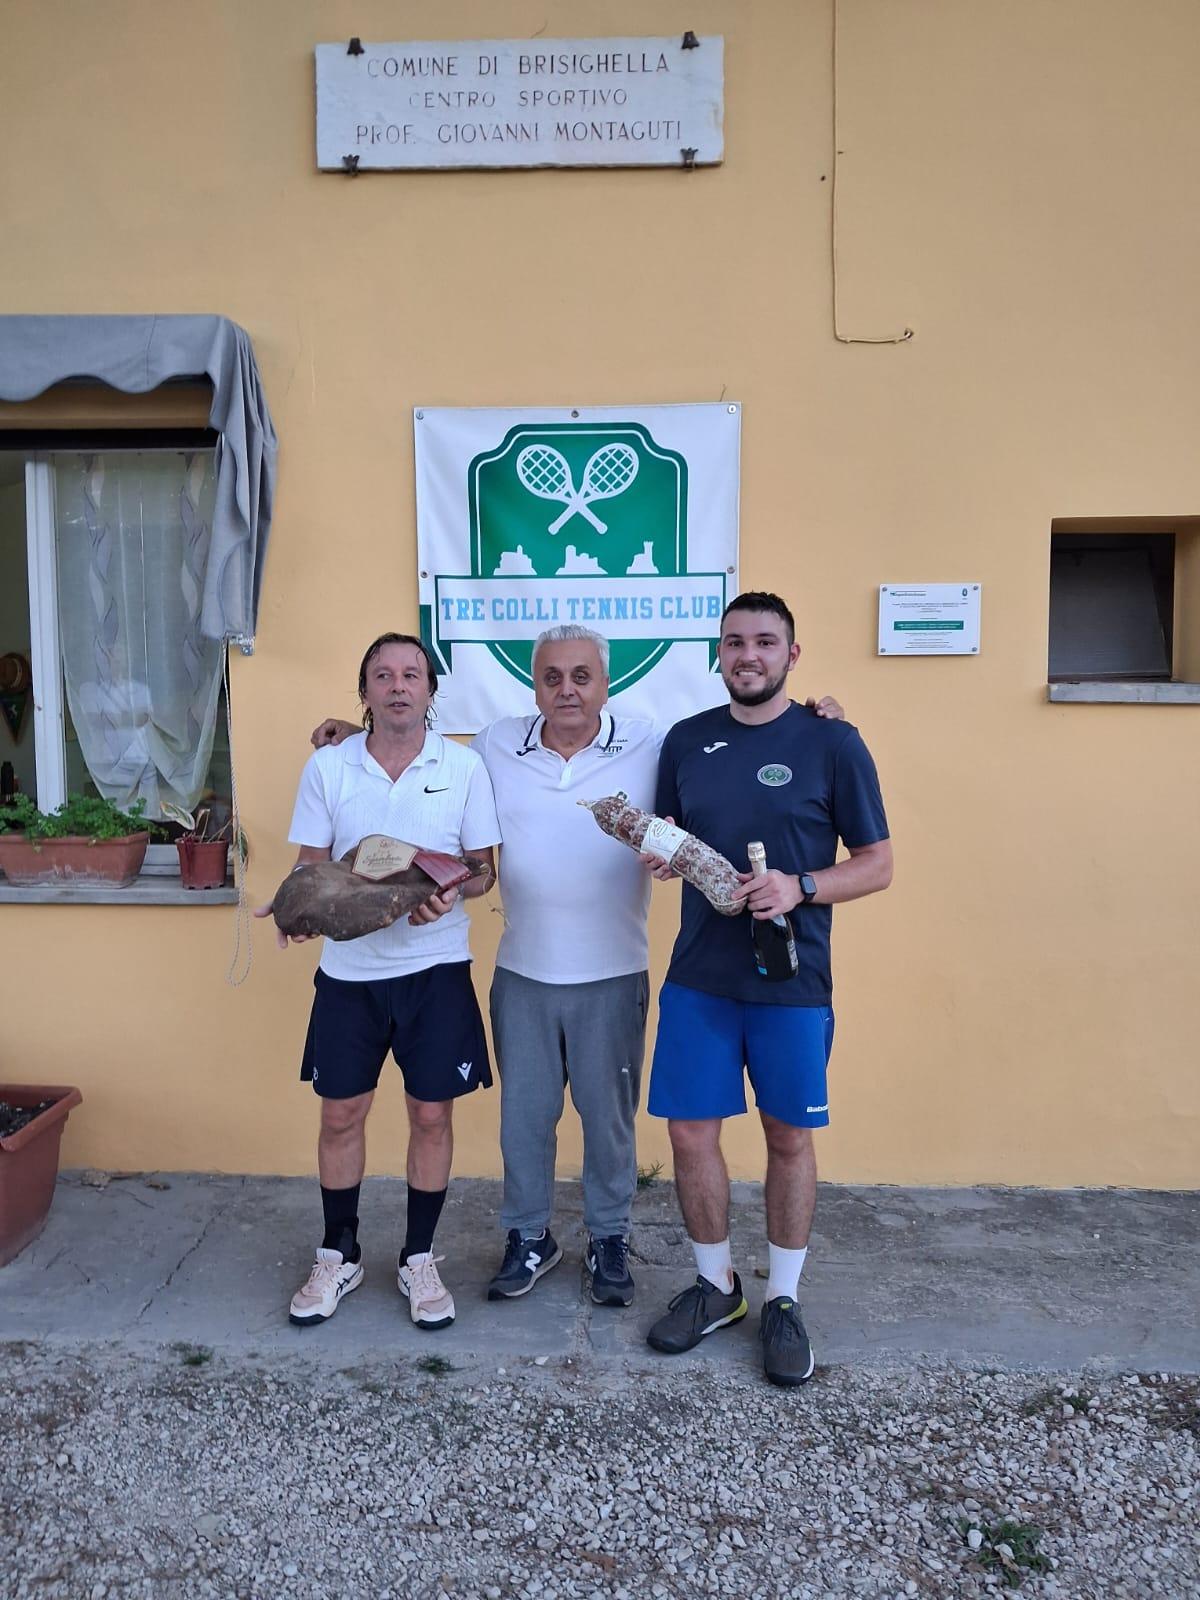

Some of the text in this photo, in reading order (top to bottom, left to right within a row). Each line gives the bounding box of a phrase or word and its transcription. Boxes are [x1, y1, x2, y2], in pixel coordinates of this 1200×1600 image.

[367, 52, 670, 77] COMUNE DI BRISIGHELLA
[409, 88, 627, 108] CENTRO SPORTIVO
[356, 120, 680, 144] PROF. GIOVANNI MONTAGUTI
[441, 596, 721, 621] TRE COLLI TENNIS CLUB
